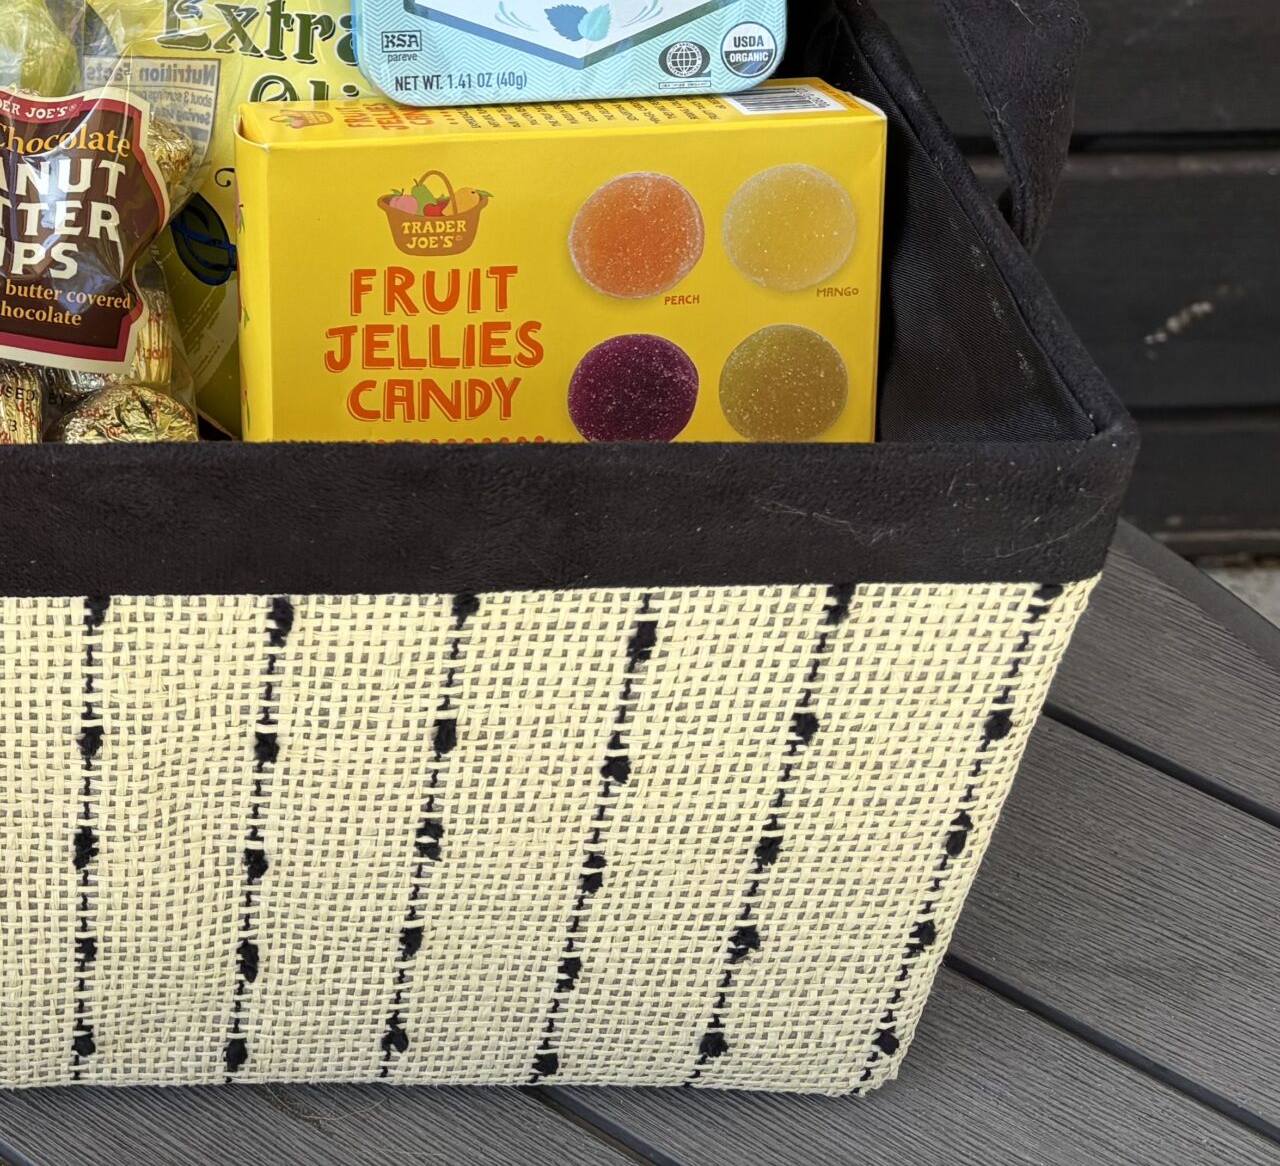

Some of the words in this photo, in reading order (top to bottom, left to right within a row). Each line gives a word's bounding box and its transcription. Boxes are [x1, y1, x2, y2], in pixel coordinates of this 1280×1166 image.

[733, 35, 765, 48] USDA
[387, 52, 419, 64] pareve
[729, 51, 769, 64] ORGANIC
[395, 75, 420, 92] NET
[422, 74, 443, 91] WT.
[447, 73, 473, 90] 1.41
[477, 72, 493, 88] OZ
[496, 71, 528, 91] (40g)
[401, 220, 467, 235] TRADER
[5, 276, 62, 301] butter
[66, 288, 132, 311] covered
[349, 265, 519, 317] FRUIT
[816, 286, 860, 298] MANGO
[663, 294, 701, 306] PEACH
[324, 320, 544, 373] JELLIES
[346, 377, 522, 423] CANDY
